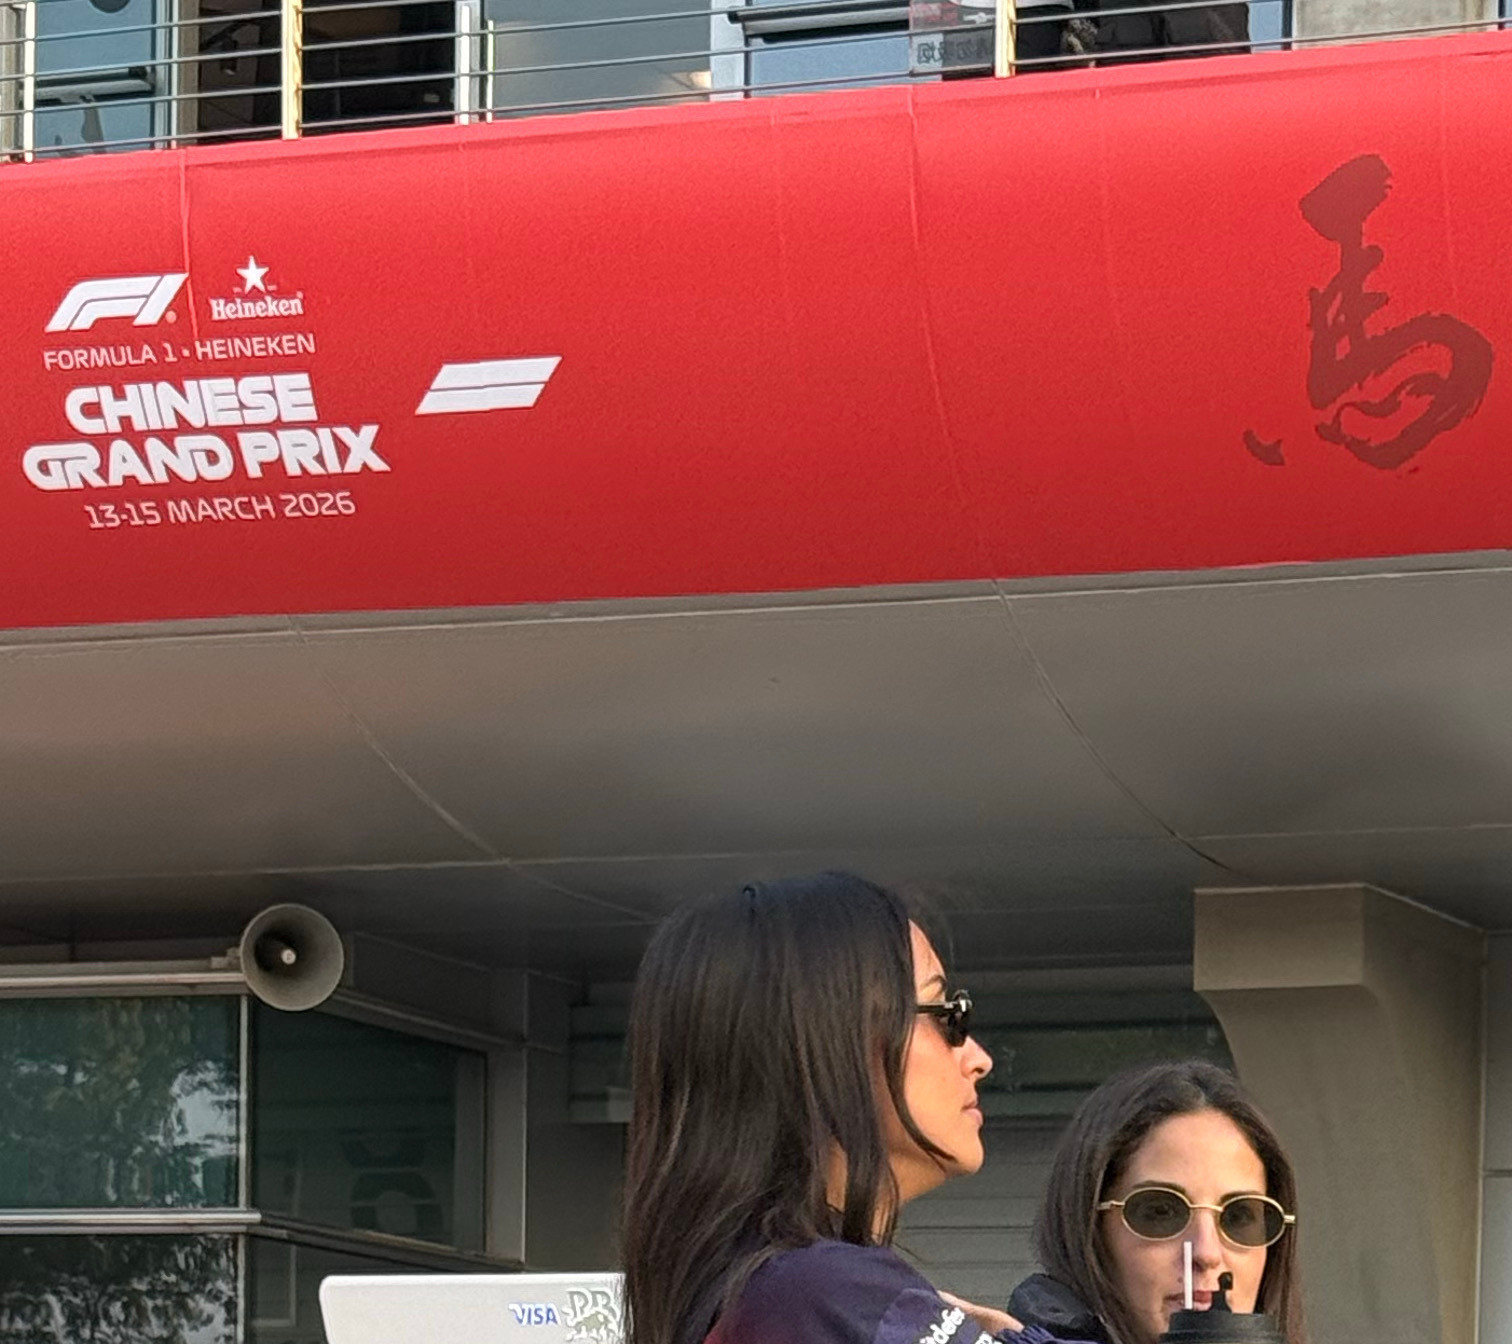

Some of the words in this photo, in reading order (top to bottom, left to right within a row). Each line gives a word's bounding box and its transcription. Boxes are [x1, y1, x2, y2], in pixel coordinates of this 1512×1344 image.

[208, 296, 305, 321] Heineken
[44, 345, 157, 371] FORMULA
[163, 342, 178, 363] 1
[194, 334, 316, 361] HEINEKEN
[64, 372, 319, 435] CHINESE
[22, 435, 234, 491] GRAND
[236, 424, 392, 479] PRIX
[84, 504, 160, 529] 13-15
[168, 496, 276, 525] MARCH
[280, 492, 356, 517] 2026
[509, 1304, 559, 1326] VISA
